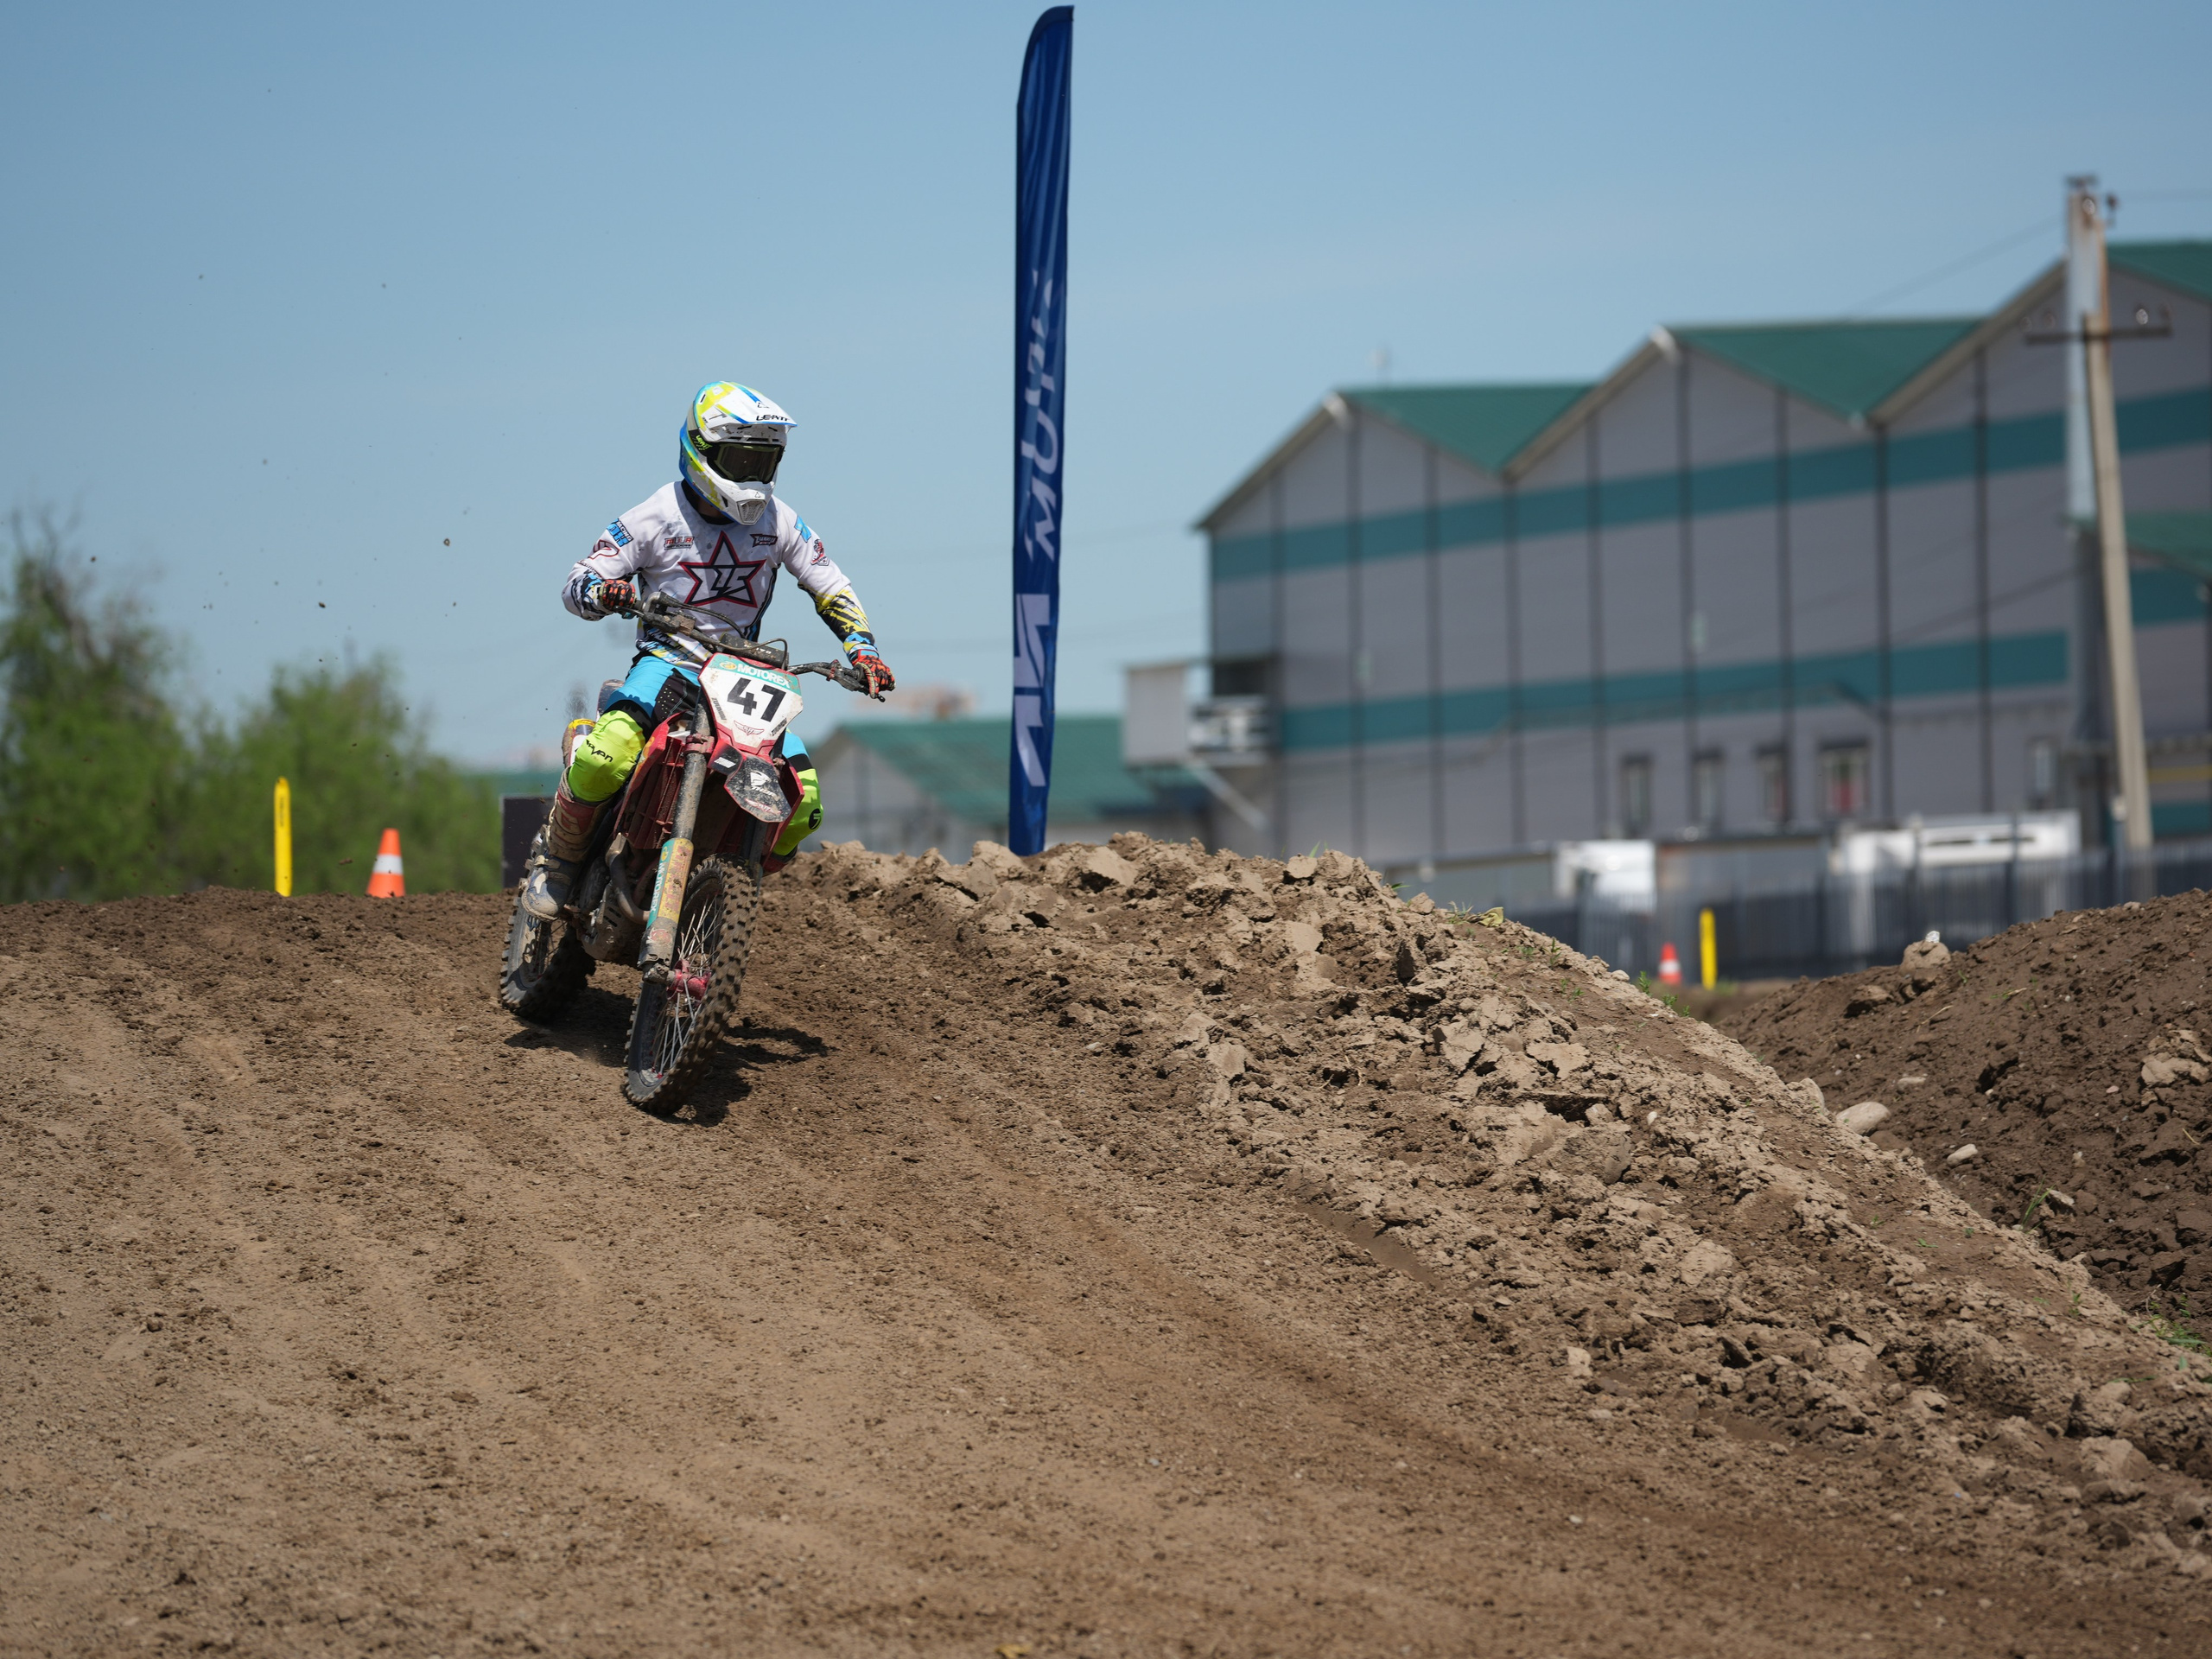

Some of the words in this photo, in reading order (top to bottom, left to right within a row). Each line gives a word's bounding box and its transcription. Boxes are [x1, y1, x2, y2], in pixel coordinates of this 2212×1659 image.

[737, 663, 791, 689] MOTOREX
[727, 677, 786, 722] 47
[650, 862, 664, 912] MOTOREX
